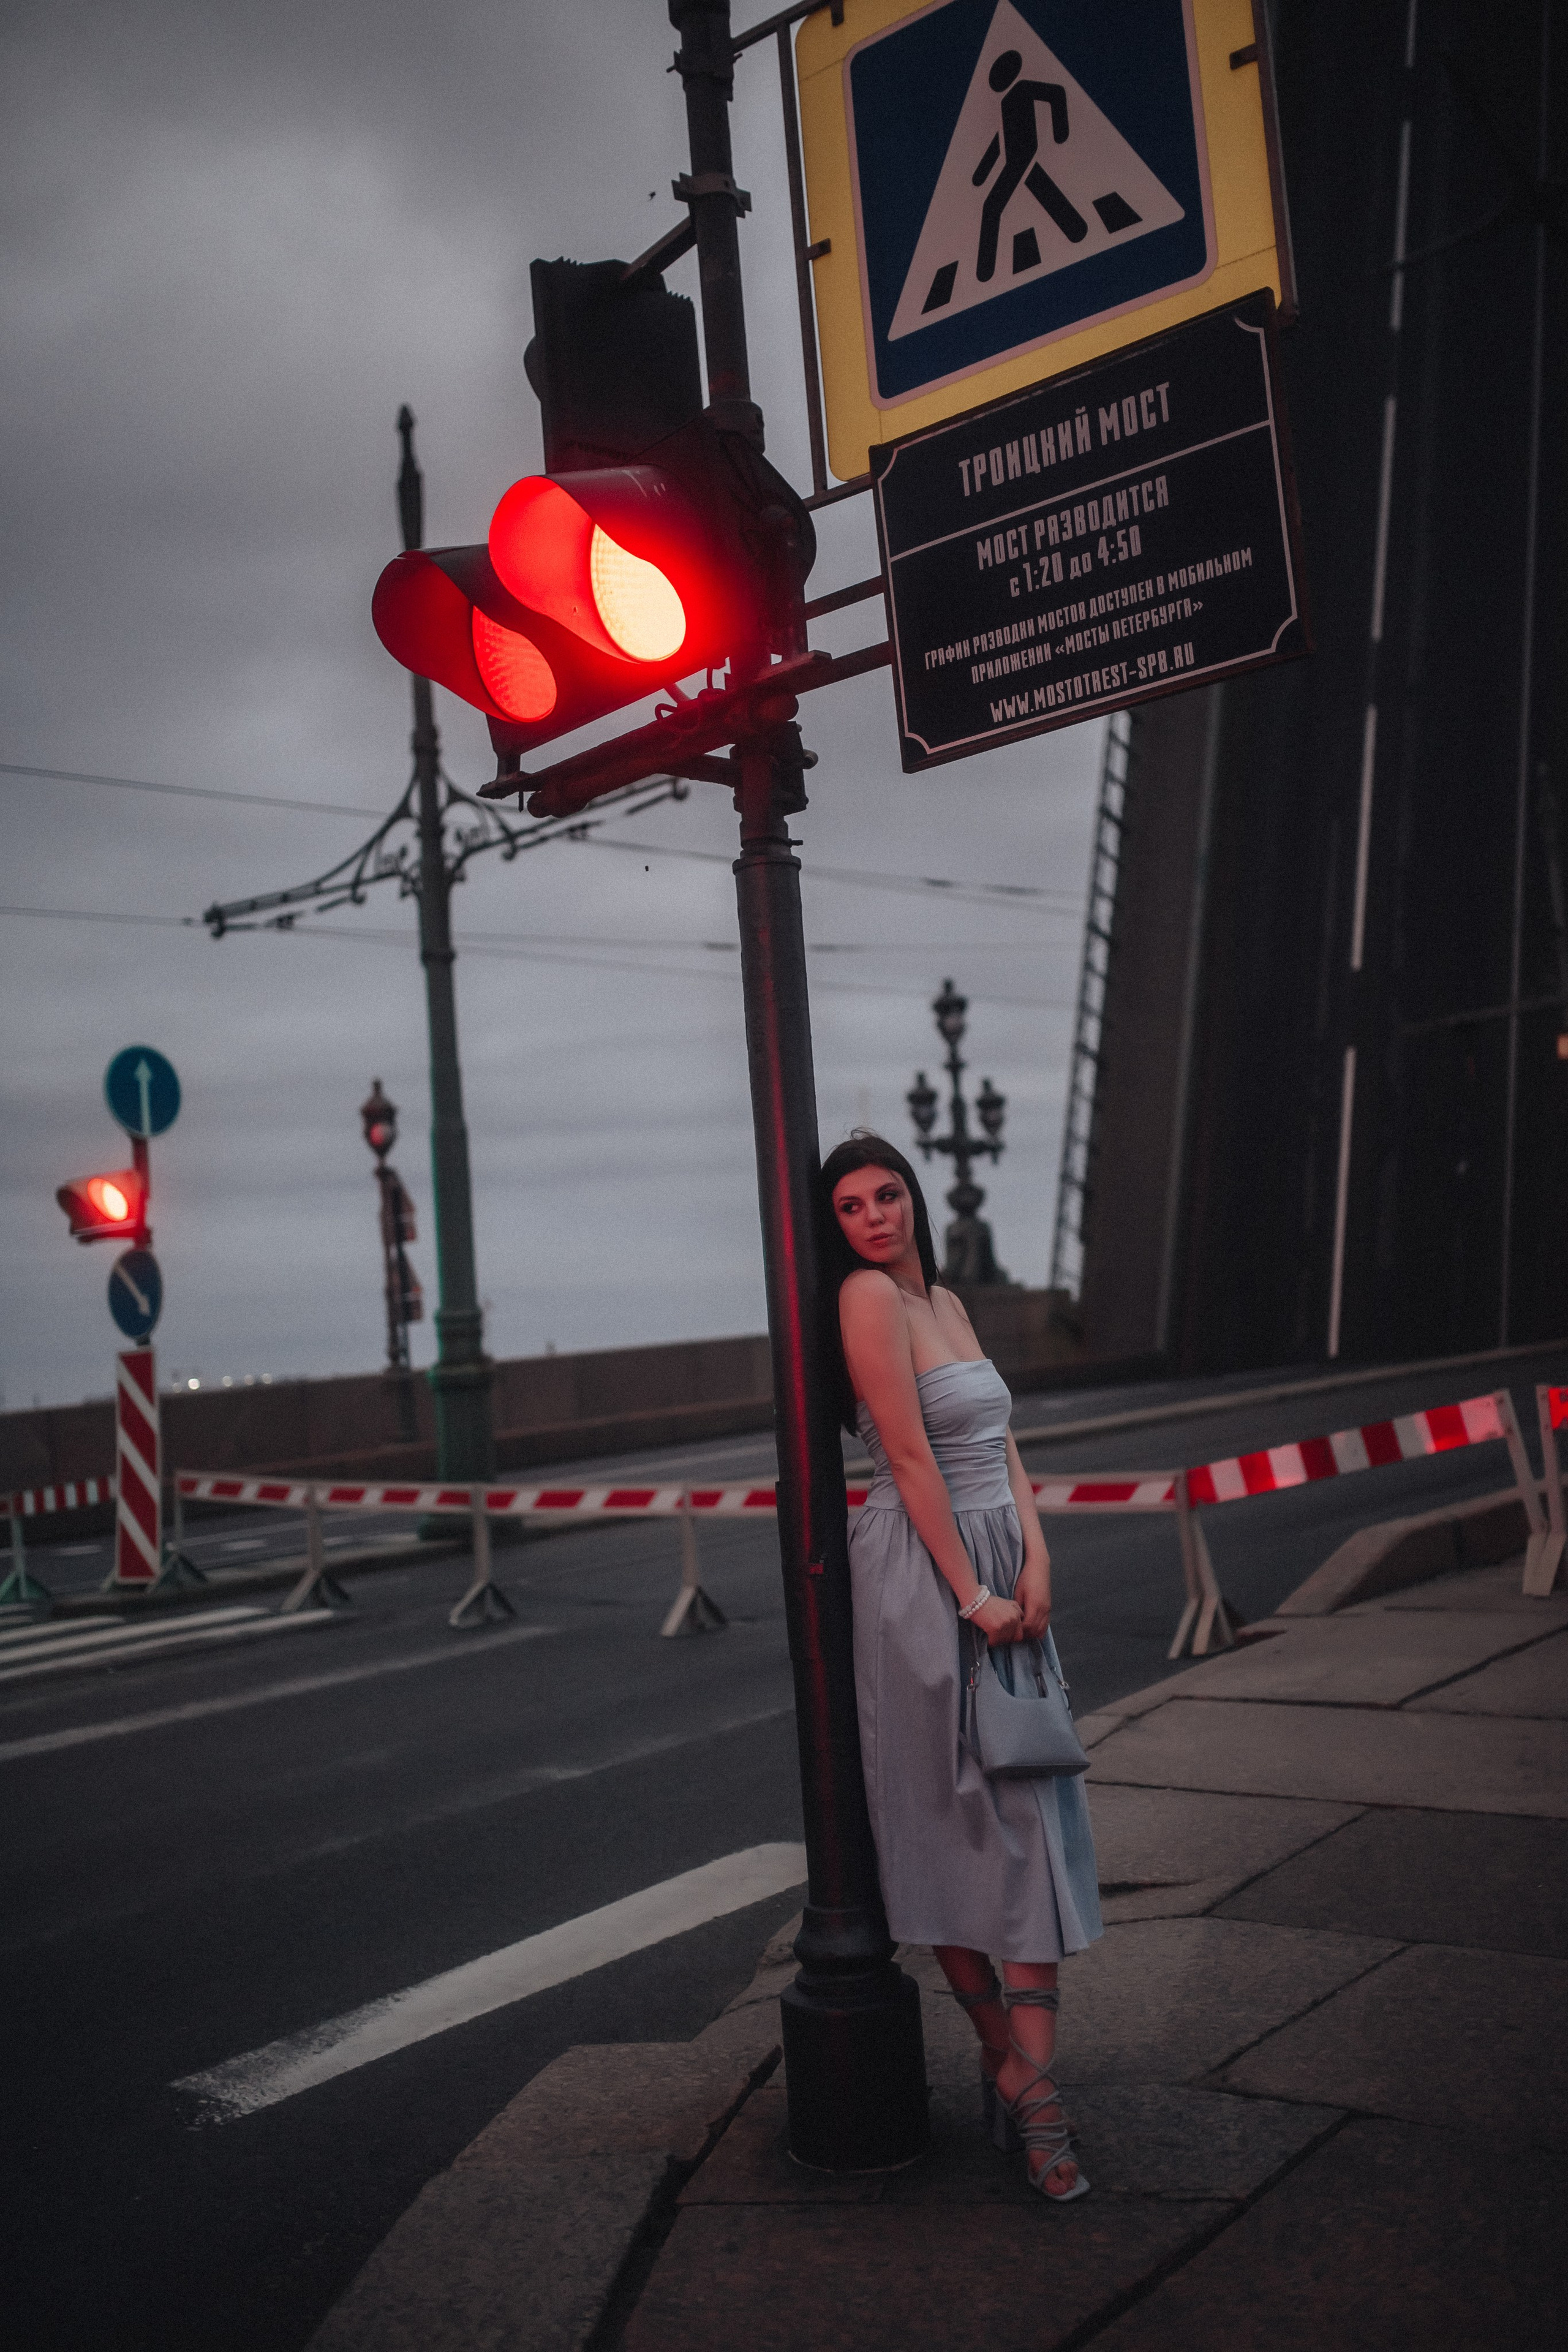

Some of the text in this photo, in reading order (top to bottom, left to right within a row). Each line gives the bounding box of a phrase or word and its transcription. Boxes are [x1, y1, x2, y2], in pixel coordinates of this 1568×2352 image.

[958, 382, 1169, 497] ТРОИЦКИЙ МОСТ
[976, 475, 1169, 570] МОСТ РАЗВОДИТСЯ
[1022, 551, 1064, 592] 1:20
[1069, 552, 1092, 580] до
[1097, 525, 1142, 567] 4:50
[924, 547, 1253, 670] ГРАФИК РАЗВОДКИ МОСТОВ ДОСТУПЕН В МОБИЛЬНОМ
[971, 598, 1204, 684] ПРИЛОЖЕНИИ «МОСТЫ ПЕТЕРБУРГА»
[989, 641, 1195, 723] WWW.MOSTOTREST-SPB.RU
